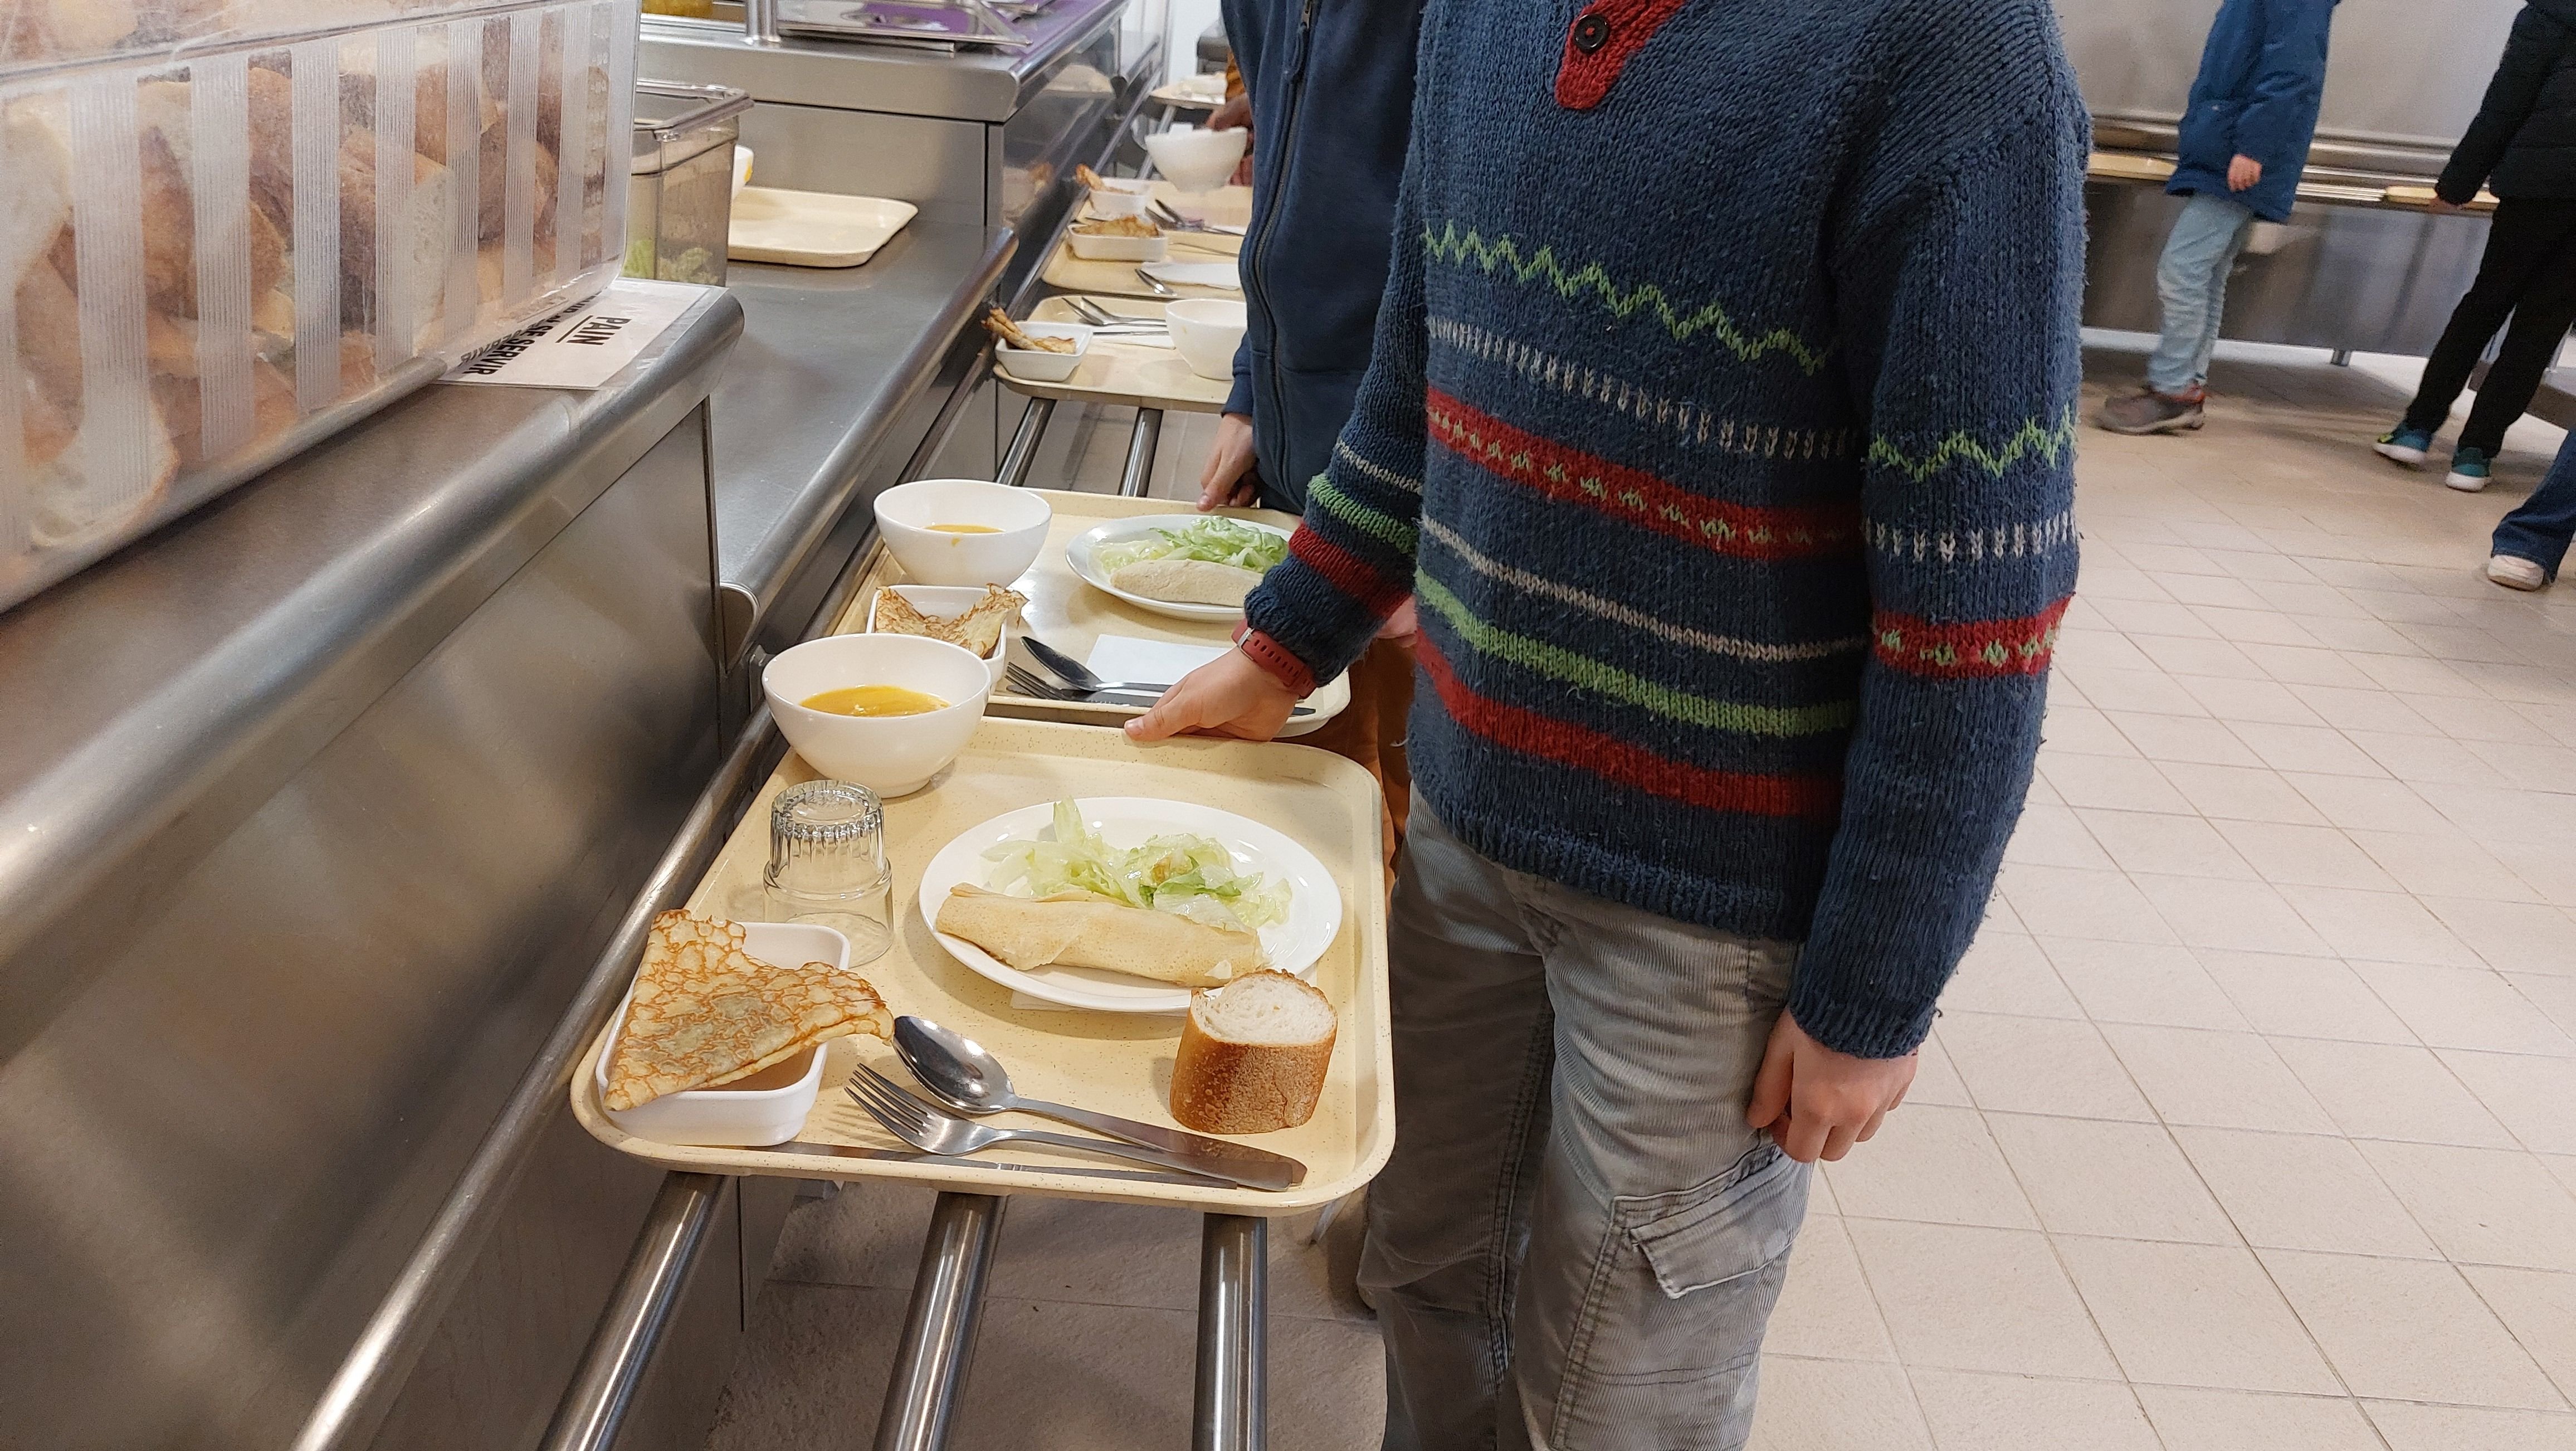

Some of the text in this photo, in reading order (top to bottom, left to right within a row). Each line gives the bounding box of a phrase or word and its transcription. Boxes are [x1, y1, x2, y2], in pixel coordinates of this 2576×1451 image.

[520, 326, 554, 337] SE
[567, 317, 632, 345] PAIN
[462, 338, 535, 374] SERVIR
